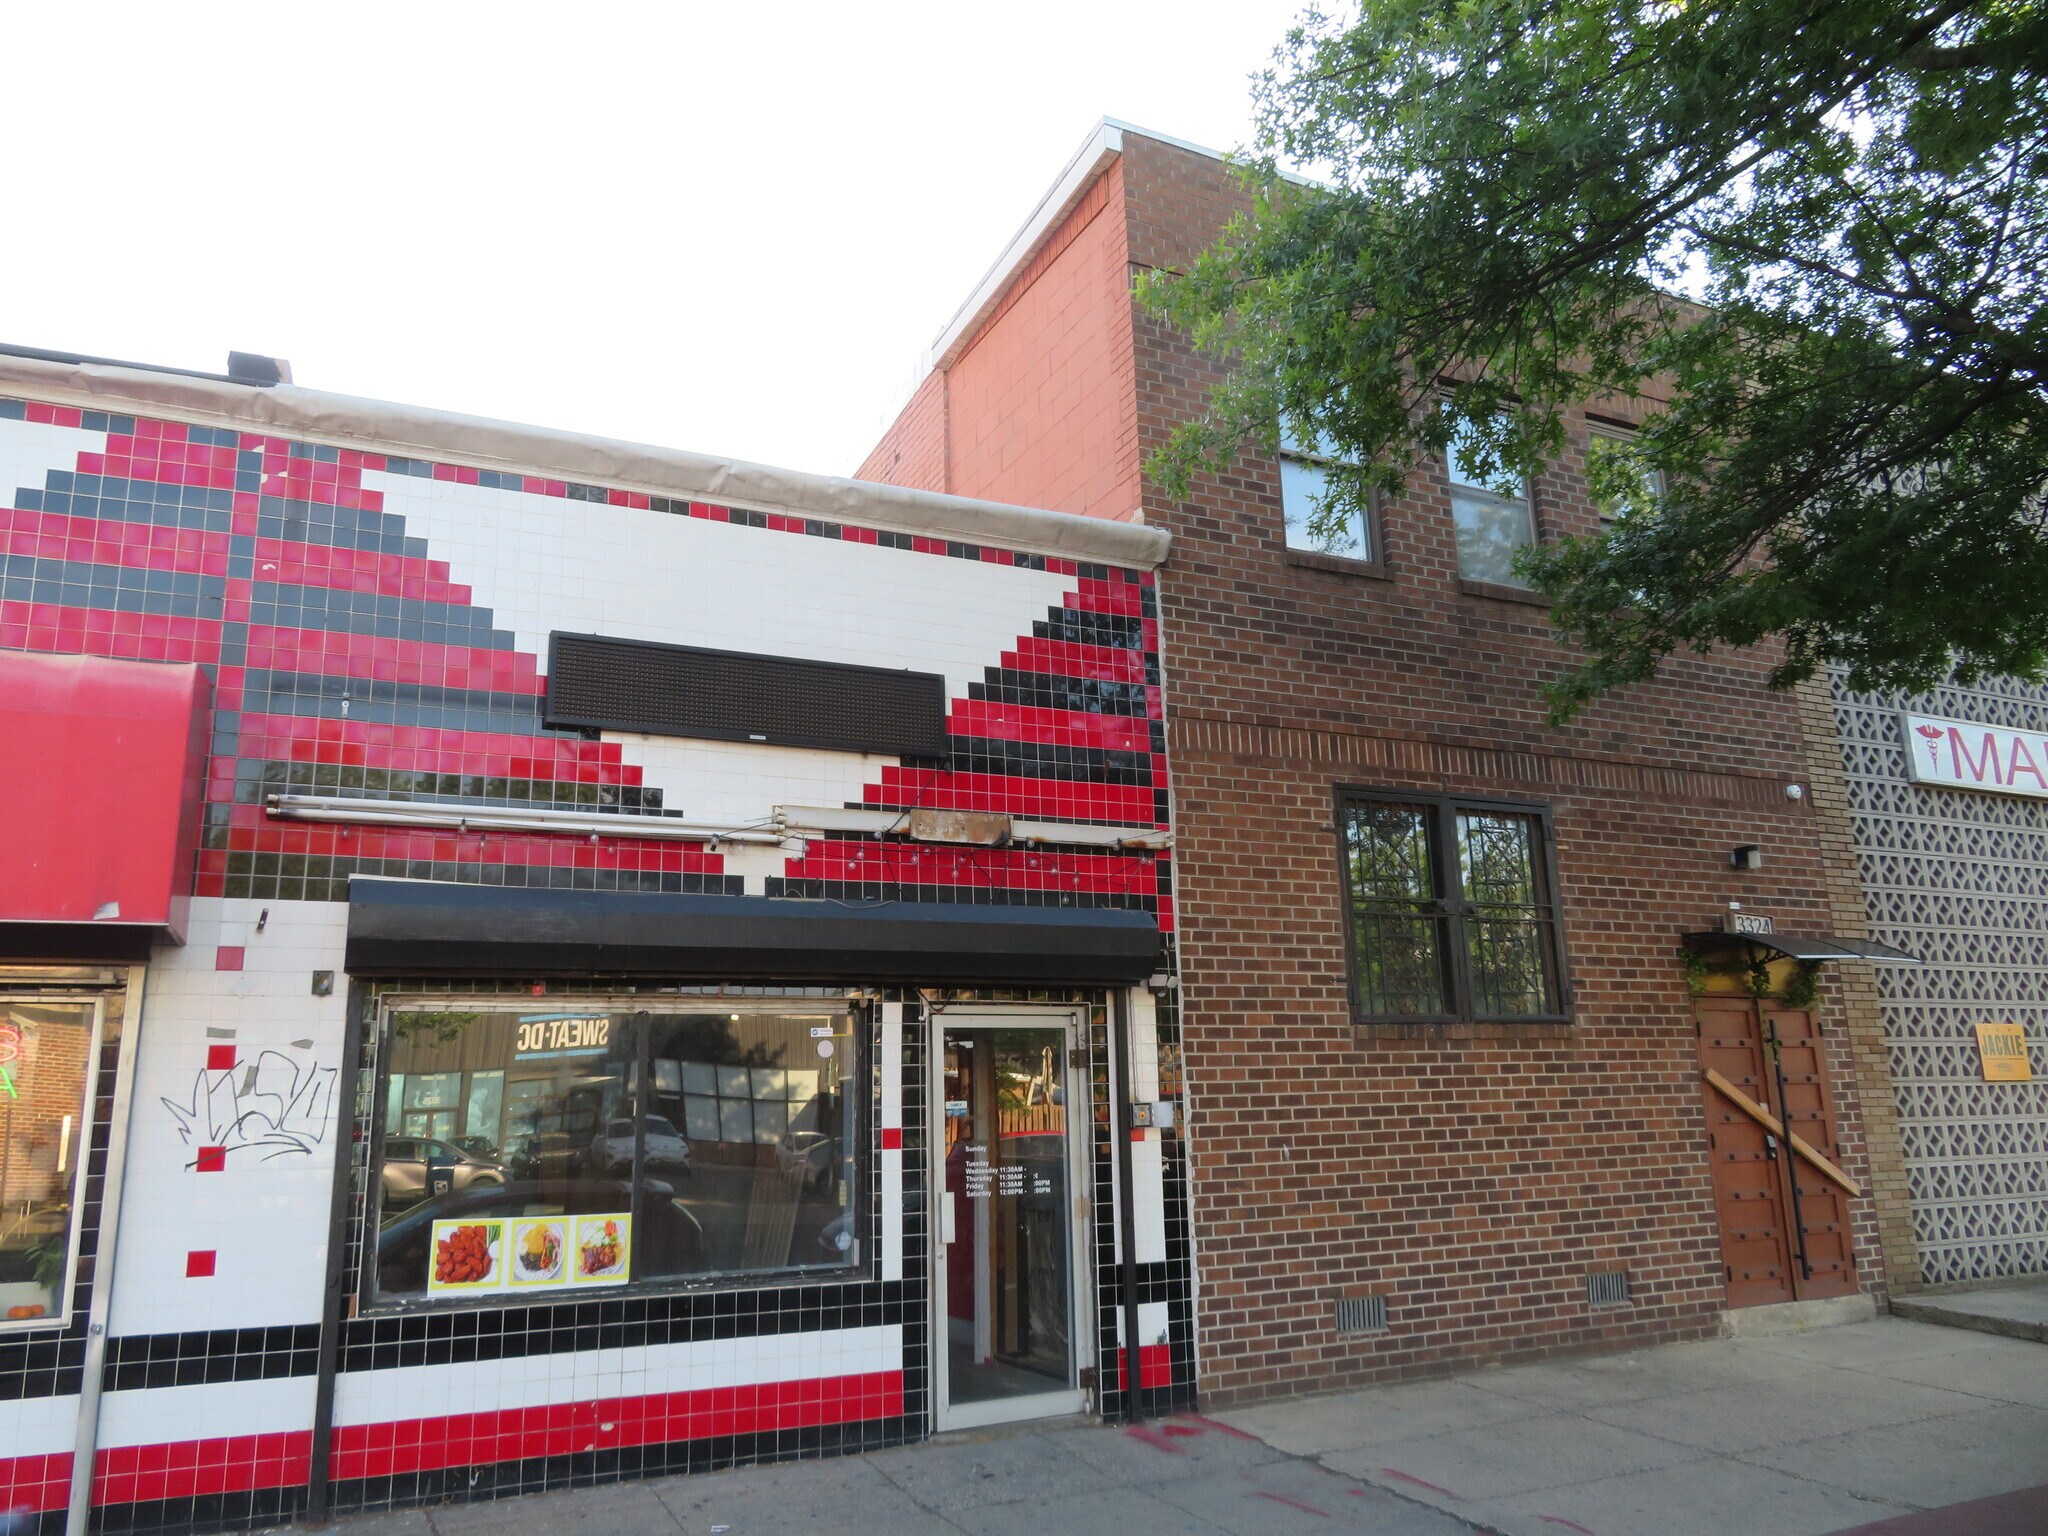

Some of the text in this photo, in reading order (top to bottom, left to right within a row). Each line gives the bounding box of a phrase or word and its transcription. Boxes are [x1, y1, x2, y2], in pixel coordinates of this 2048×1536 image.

[1947, 727, 2048, 790] MA
[1982, 1035, 2024, 1056] JACKIE
[965, 1145, 987, 1153] Sunday
[966, 1182, 984, 1190] Friday
